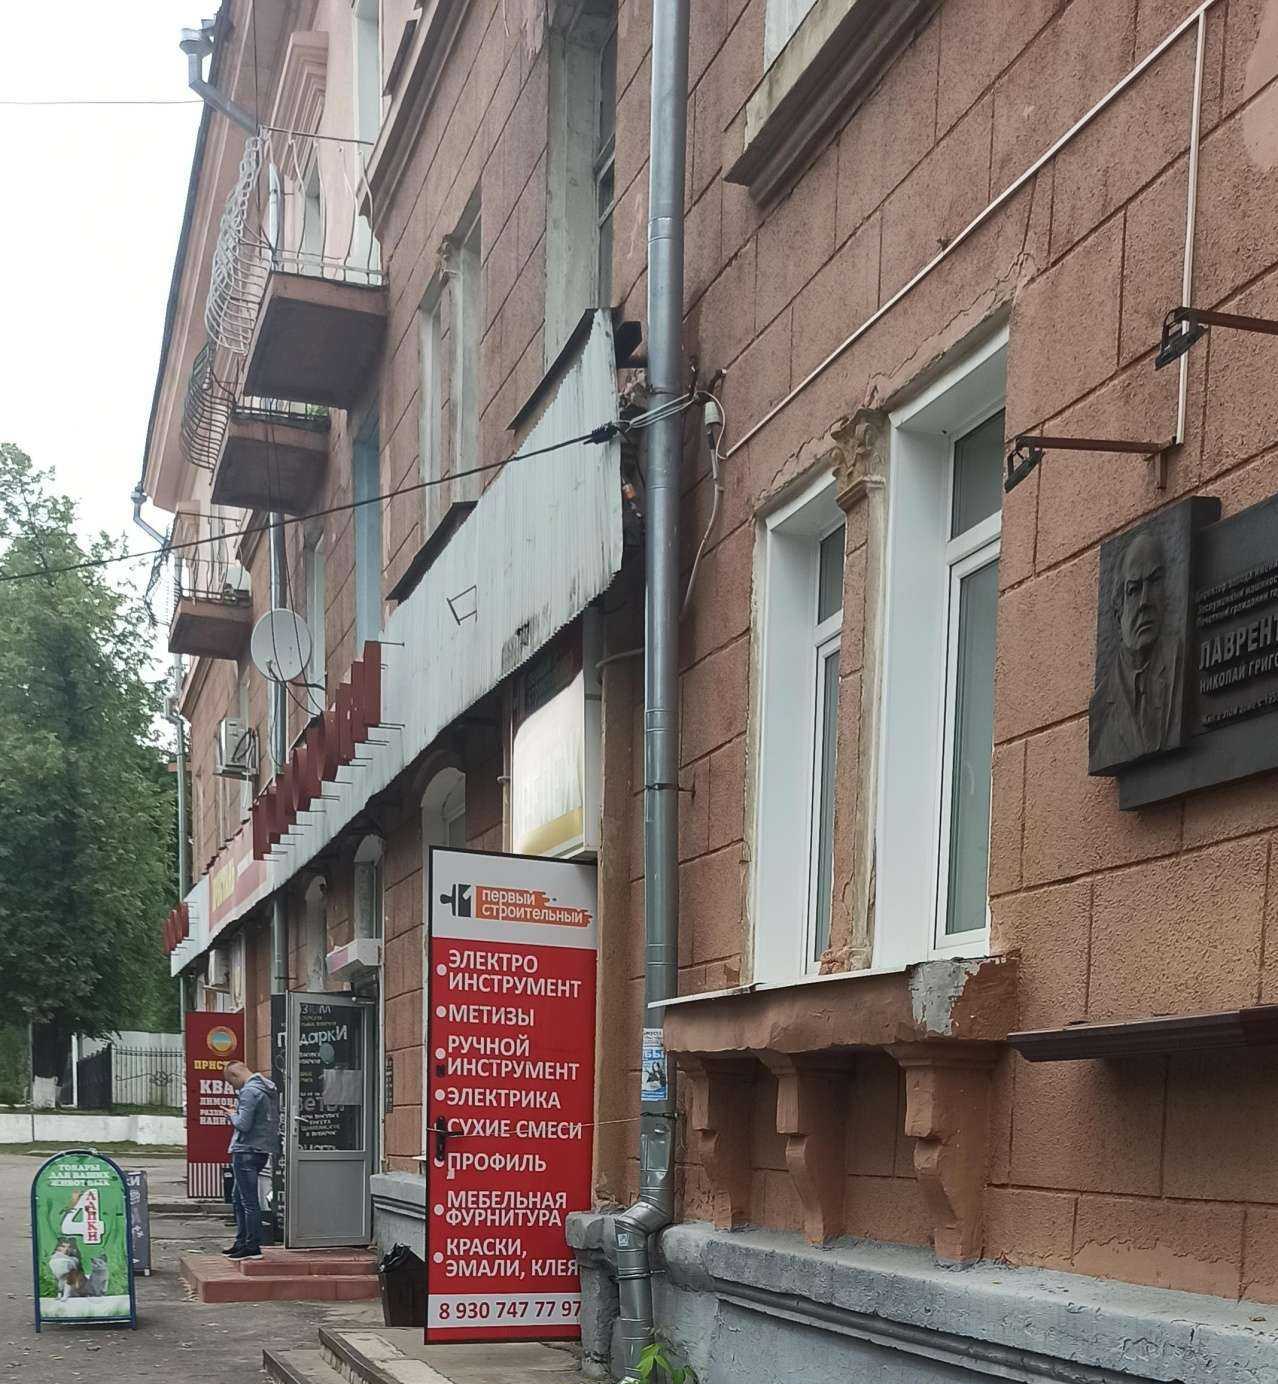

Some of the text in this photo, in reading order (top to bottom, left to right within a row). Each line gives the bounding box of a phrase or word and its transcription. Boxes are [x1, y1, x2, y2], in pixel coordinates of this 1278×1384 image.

[482, 888, 536, 906] первый
[482, 904, 583, 925] строительный
[449, 949, 538, 973] ЭЛЕКТРО
[449, 973, 582, 999] ИНСТРУМЕНТ
[449, 1004, 534, 1026] МЕТИЗЫ
[448, 1034, 530, 1057] РУЧНОЙ
[447, 1058, 580, 1081] ИНСТРУМЕНТ
[447, 1088, 561, 1110] ЭЛЕКТРИКА
[447, 1118, 582, 1140] СУХИЕ СМЕСИ
[447, 1152, 547, 1173] ПРОФИЛЬ
[447, 1190, 567, 1209] МЕБЕЛЬНАЯ
[446, 1208, 562, 1227] ФУРНИТУРА
[446, 1238, 527, 1258] КРАСКИ,
[446, 1259, 578, 1280] ЭМАЛИ, КЛЕЯ
[439, 1301, 581, 1320] 8 930 747 77 97
